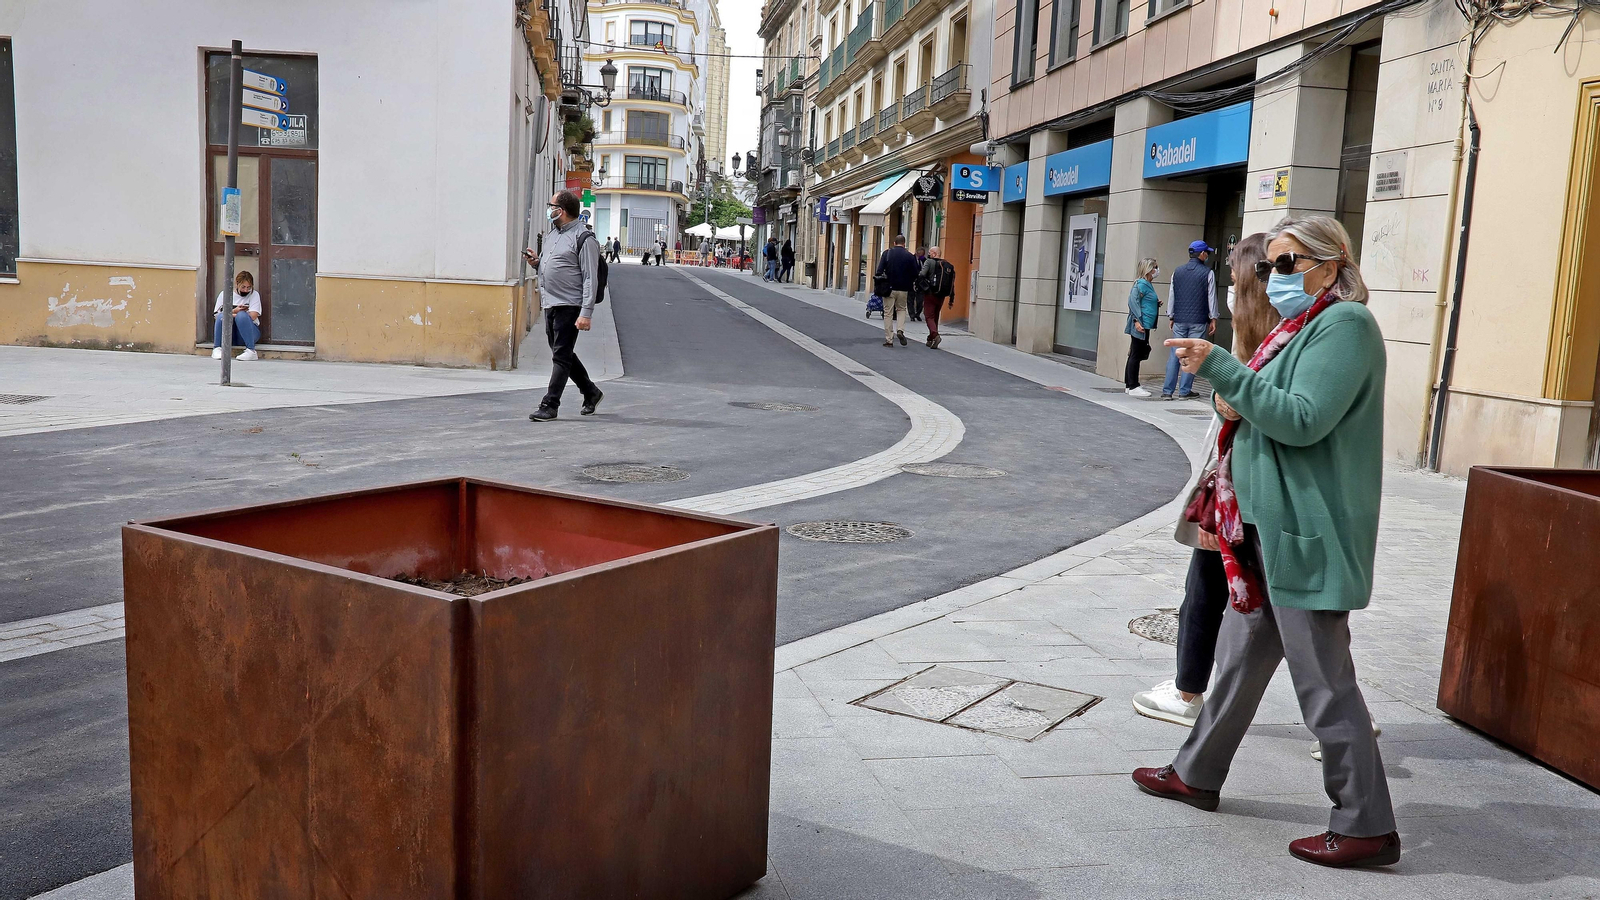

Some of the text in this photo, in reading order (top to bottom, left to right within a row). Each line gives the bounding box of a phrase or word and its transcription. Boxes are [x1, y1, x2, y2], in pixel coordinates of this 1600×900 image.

[1430, 59, 1455, 75] SANTA
[1427, 78, 1453, 94] MARIA
[1156, 136, 1197, 168] Sabadell
[969, 170, 983, 188] S
[1052, 164, 1079, 188] Sabadell
[965, 192, 987, 200] ServiRed
